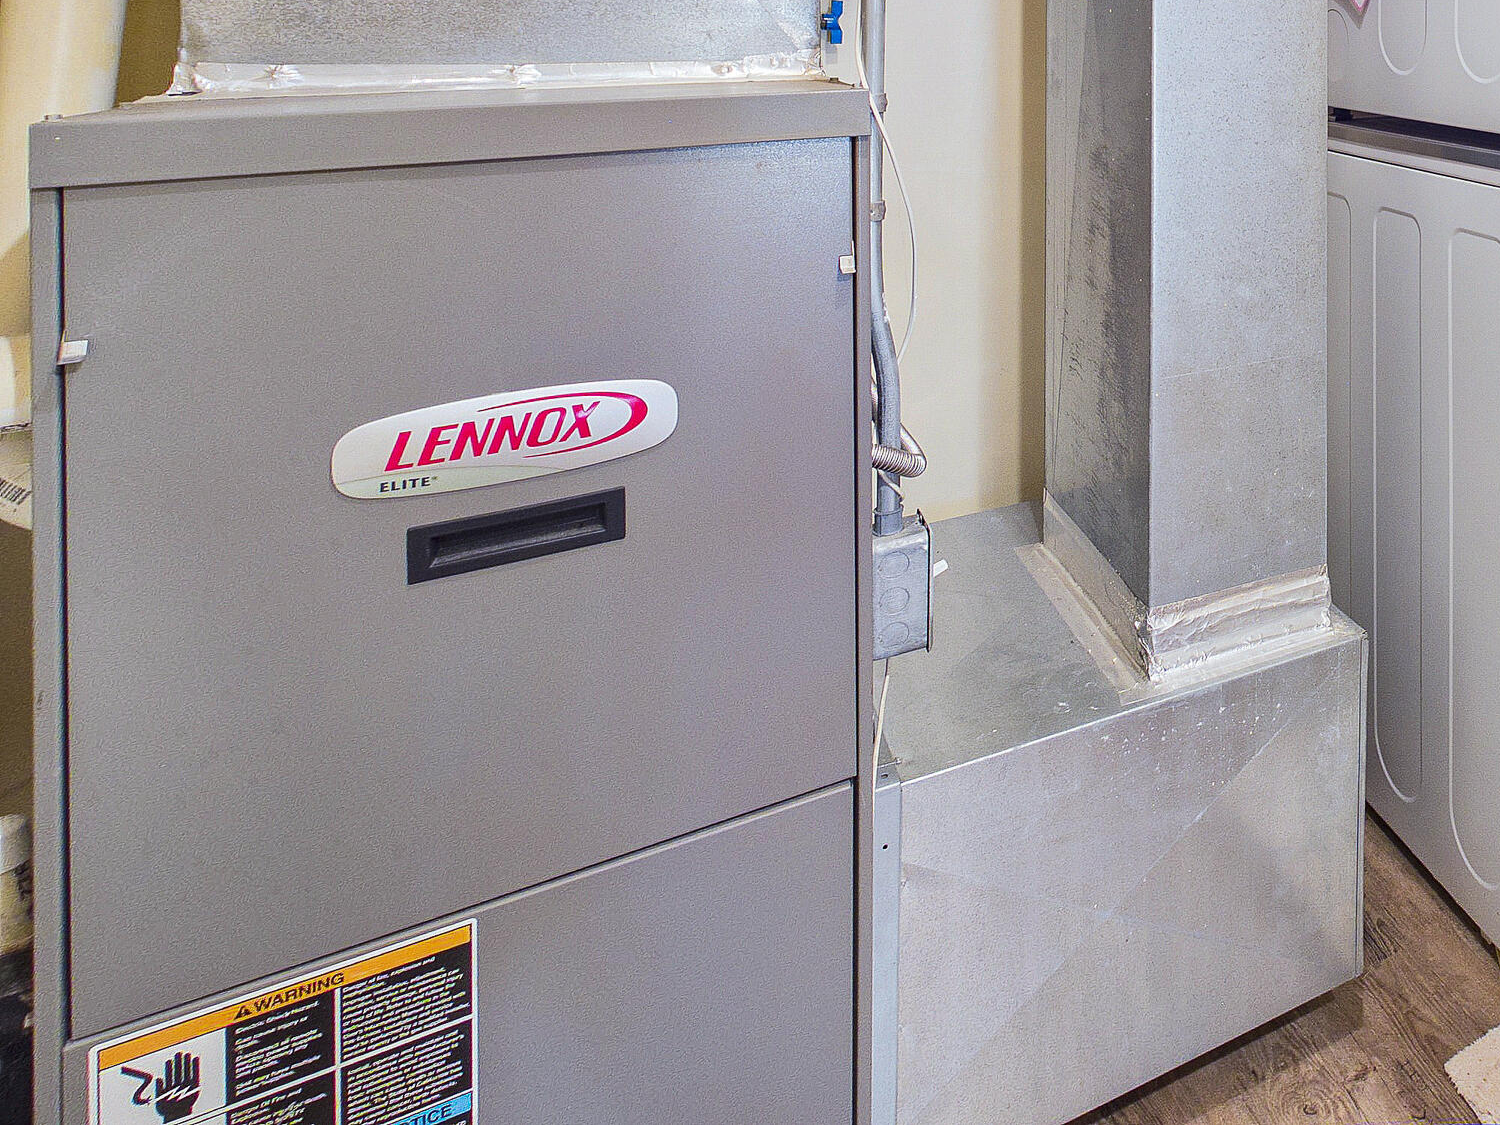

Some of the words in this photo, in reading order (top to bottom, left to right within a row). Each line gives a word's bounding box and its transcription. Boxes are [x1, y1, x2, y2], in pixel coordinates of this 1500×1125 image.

[383, 400, 601, 473] LENNOX
[254, 973, 345, 1013] WARNING
[399, 1104, 452, 1125] TICE
